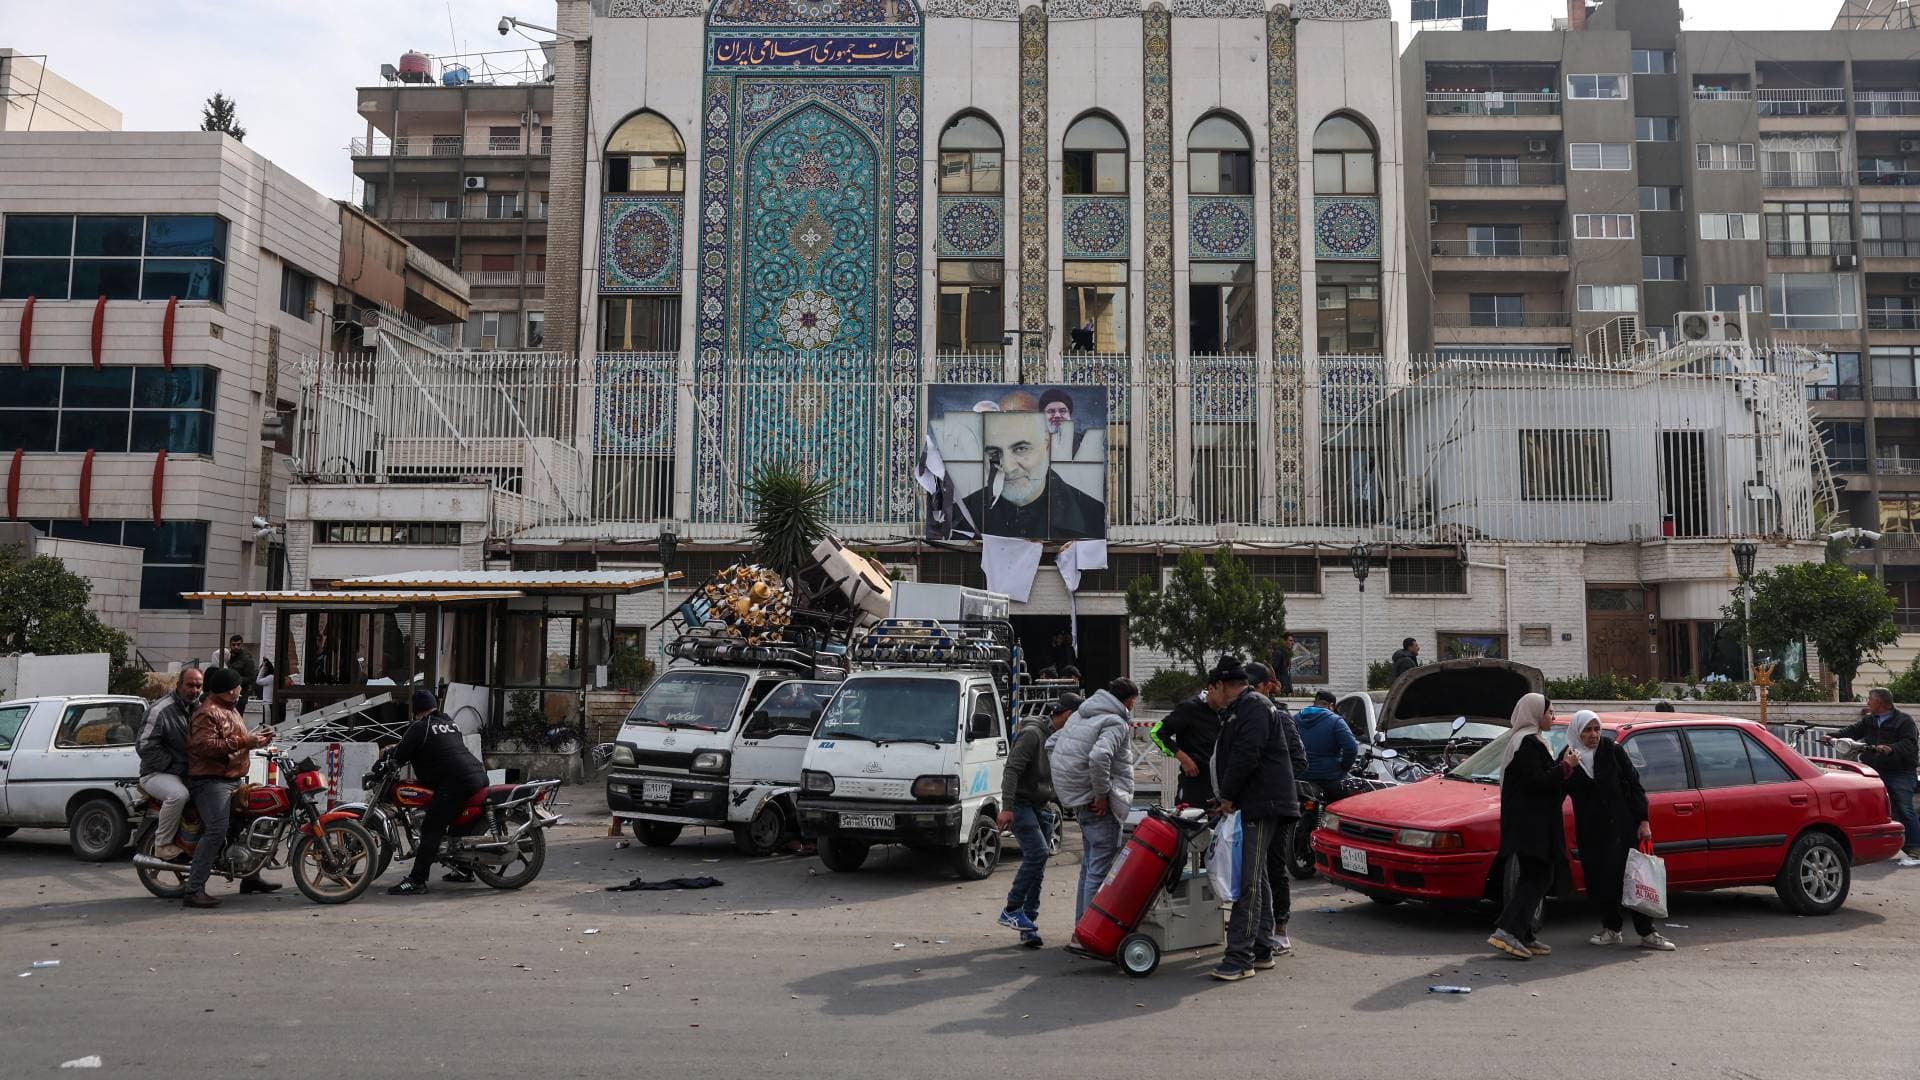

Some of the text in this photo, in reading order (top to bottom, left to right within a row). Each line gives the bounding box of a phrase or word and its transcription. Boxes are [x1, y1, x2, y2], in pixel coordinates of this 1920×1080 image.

[717, 41, 752, 66] ایران
[750, 39, 817, 64] اسلامی
[852, 40, 913, 60] سفارت
[818, 741, 836, 749] KIA
